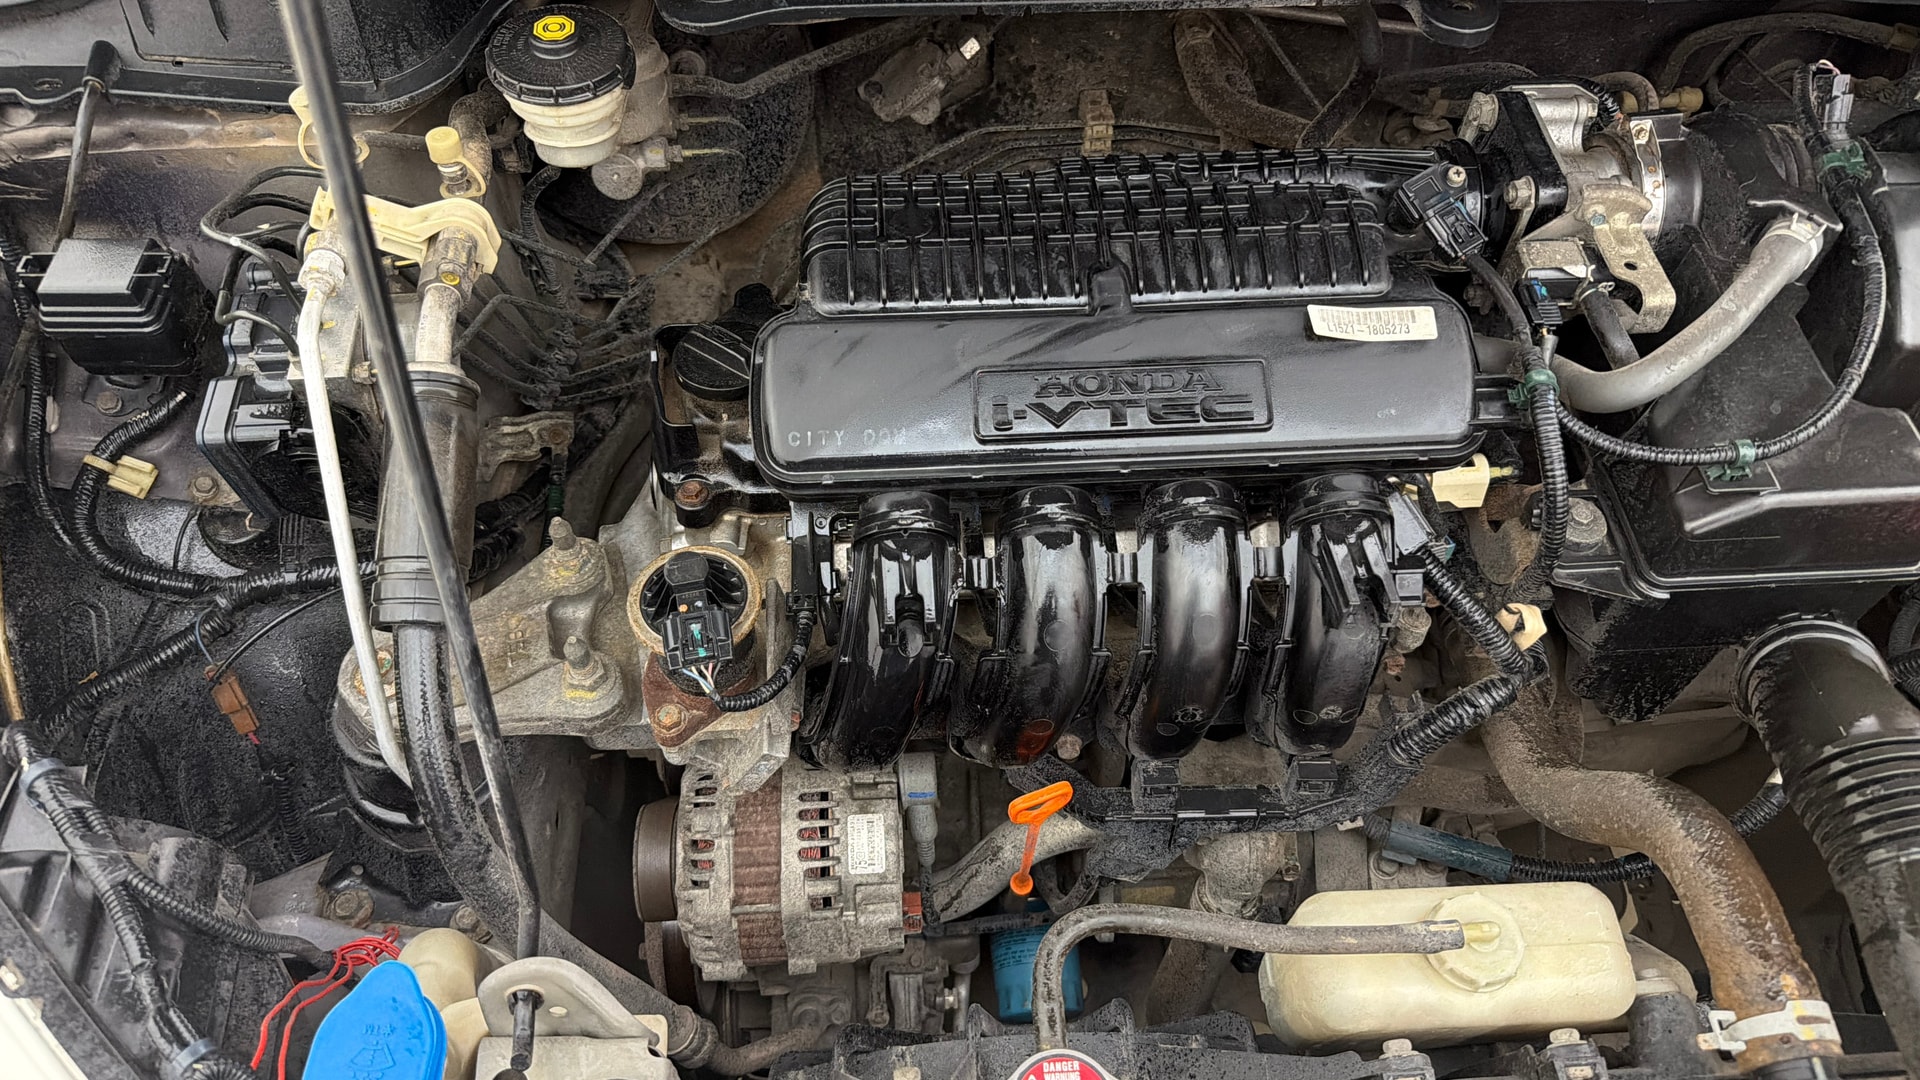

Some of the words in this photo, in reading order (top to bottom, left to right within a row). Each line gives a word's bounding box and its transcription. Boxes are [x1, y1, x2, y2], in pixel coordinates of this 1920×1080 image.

[1033, 369, 1224, 398] HONDA
[992, 394, 1255, 432] i-VTEC
[788, 430, 844, 447] CITY
[1043, 1060, 1080, 1073] DANGER
